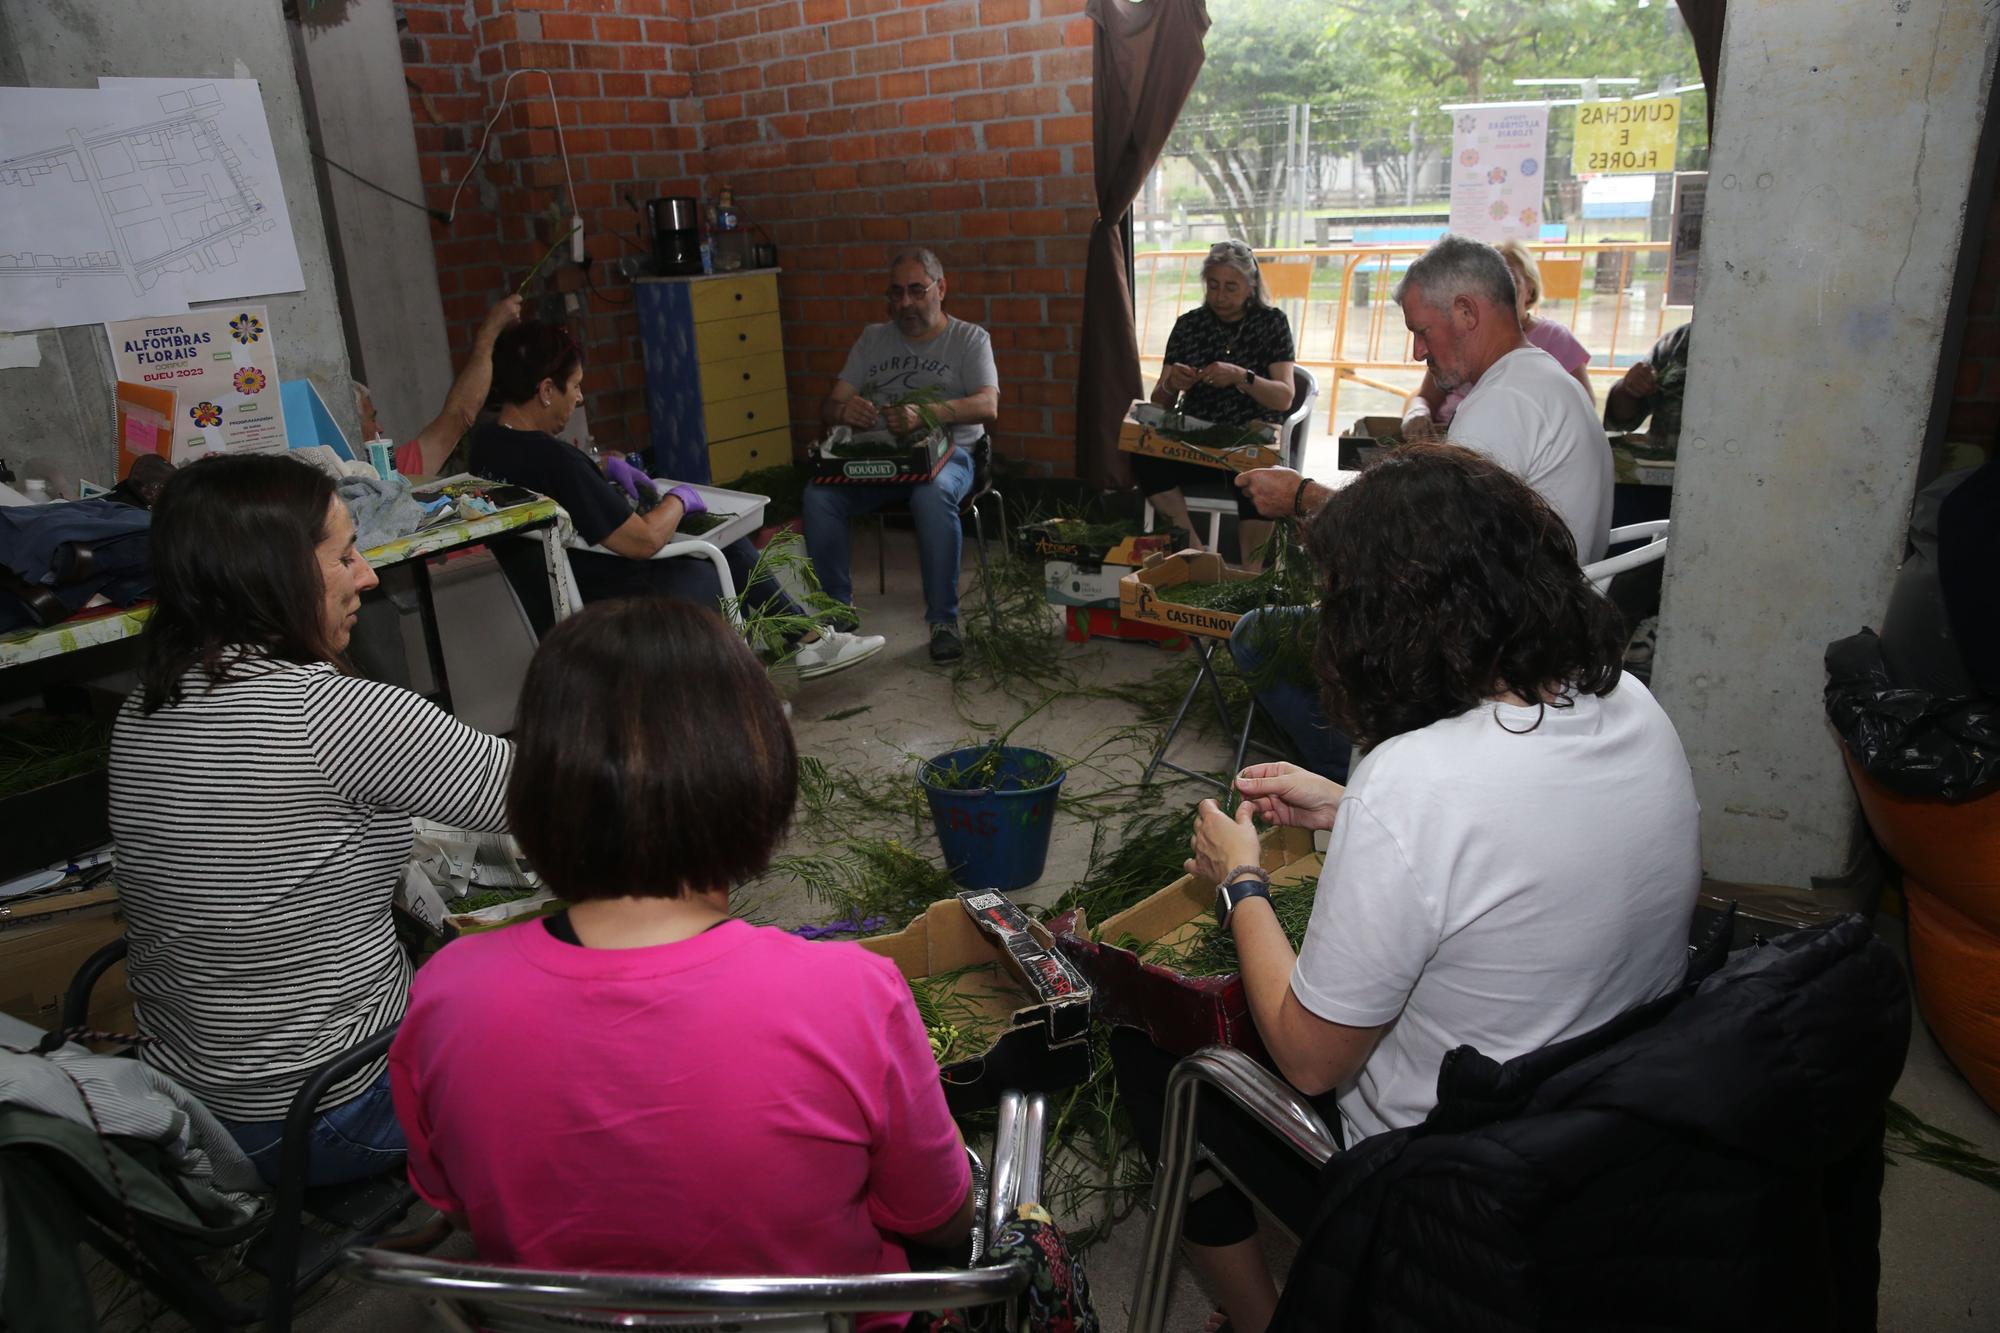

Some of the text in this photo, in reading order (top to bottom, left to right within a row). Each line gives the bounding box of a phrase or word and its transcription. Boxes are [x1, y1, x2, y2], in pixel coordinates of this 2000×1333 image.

[145, 326, 185, 337] FESTA
[124, 332, 212, 353] ALFOMBRAS
[137, 347, 198, 365] FLORAIS
[144, 368, 204, 382] BUEU 2023
[848, 464, 892, 475] BOUQUET
[1166, 609, 1238, 632] CASTELNOV
